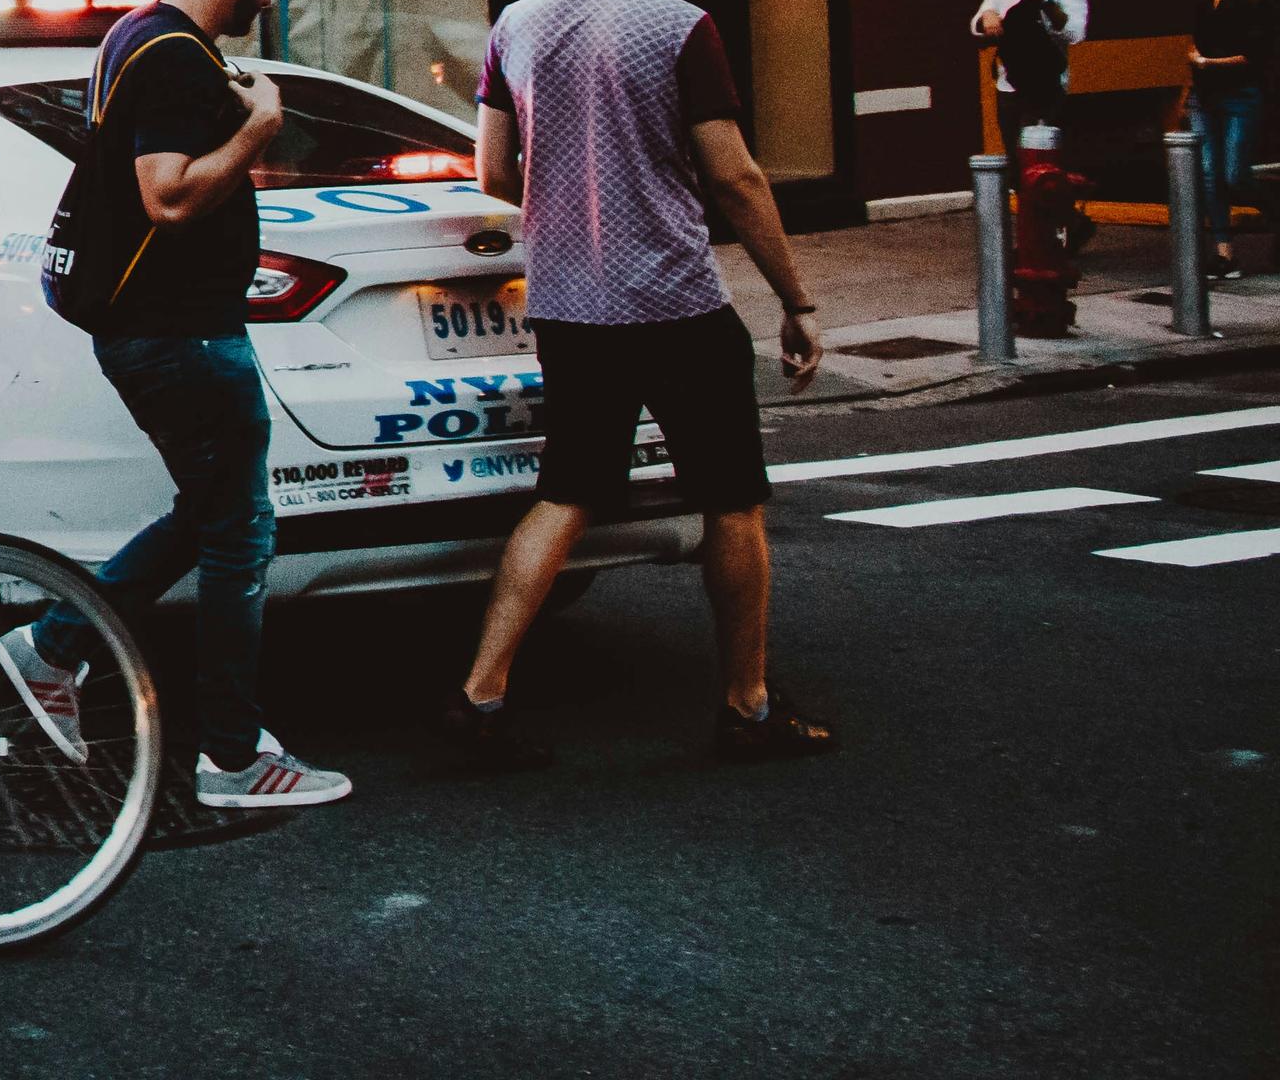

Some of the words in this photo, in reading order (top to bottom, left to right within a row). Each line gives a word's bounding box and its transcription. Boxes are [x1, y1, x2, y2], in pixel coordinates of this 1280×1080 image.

[430, 301, 506, 339] 5019
[272, 463, 340, 487] $10,000
[342, 455, 410, 478] REWARD
[279, 493, 305, 507] CALL
